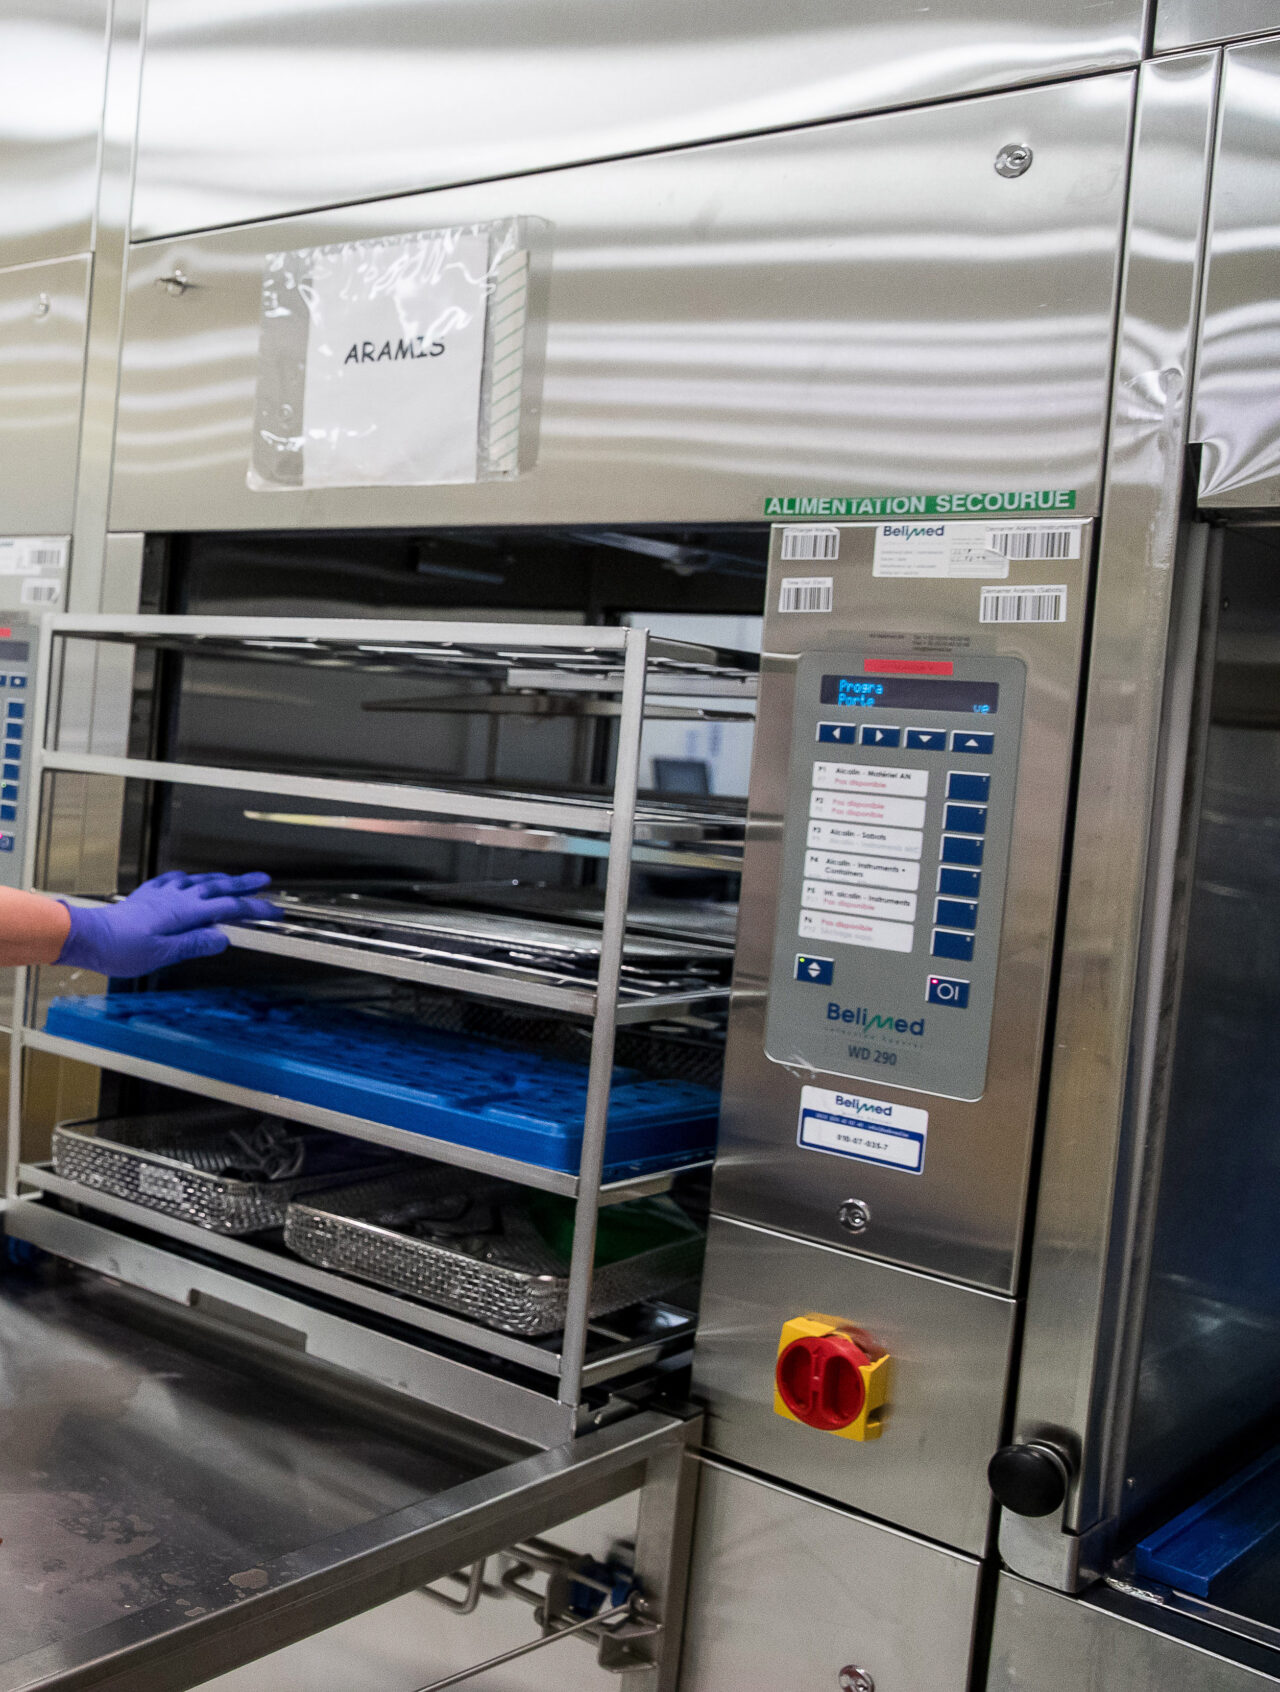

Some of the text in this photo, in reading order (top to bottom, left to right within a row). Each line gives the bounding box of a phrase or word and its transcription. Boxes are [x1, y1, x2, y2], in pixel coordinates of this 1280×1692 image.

[344, 336, 446, 365] ARAMIS
[767, 490, 1070, 515] ALIMENTATION SECOURUE
[848, 1045, 897, 1066] WD 290
